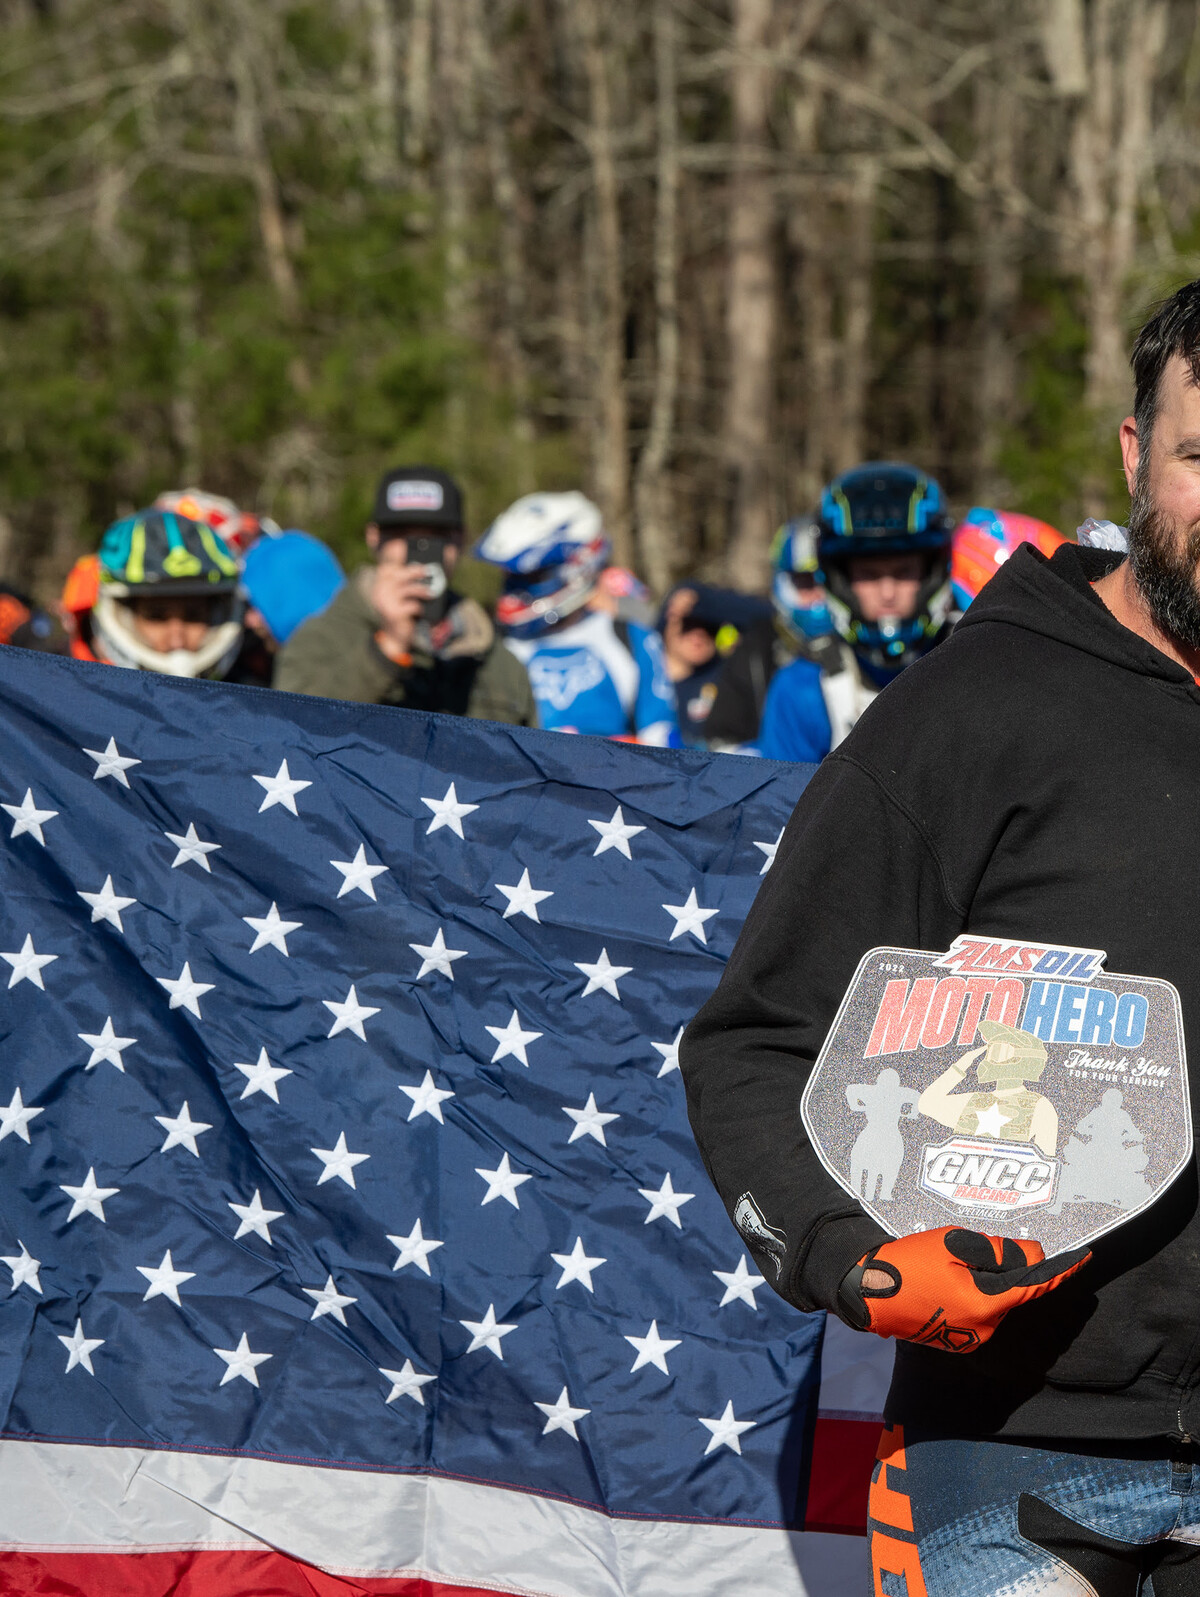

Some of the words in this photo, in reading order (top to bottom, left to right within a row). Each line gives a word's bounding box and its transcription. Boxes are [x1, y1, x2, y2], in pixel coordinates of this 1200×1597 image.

[878, 962, 906, 974] 2022
[943, 939, 1099, 979] AMSOIL
[1063, 1049, 1129, 1072] Thank
[1131, 1057, 1172, 1078] You
[1069, 1070, 1087, 1079] FOR
[1092, 1073, 1118, 1083] YOUR
[1122, 1076, 1166, 1088] SERVICE
[926, 1151, 1052, 1193] GNCC
[954, 1185, 1019, 1204] RACING
